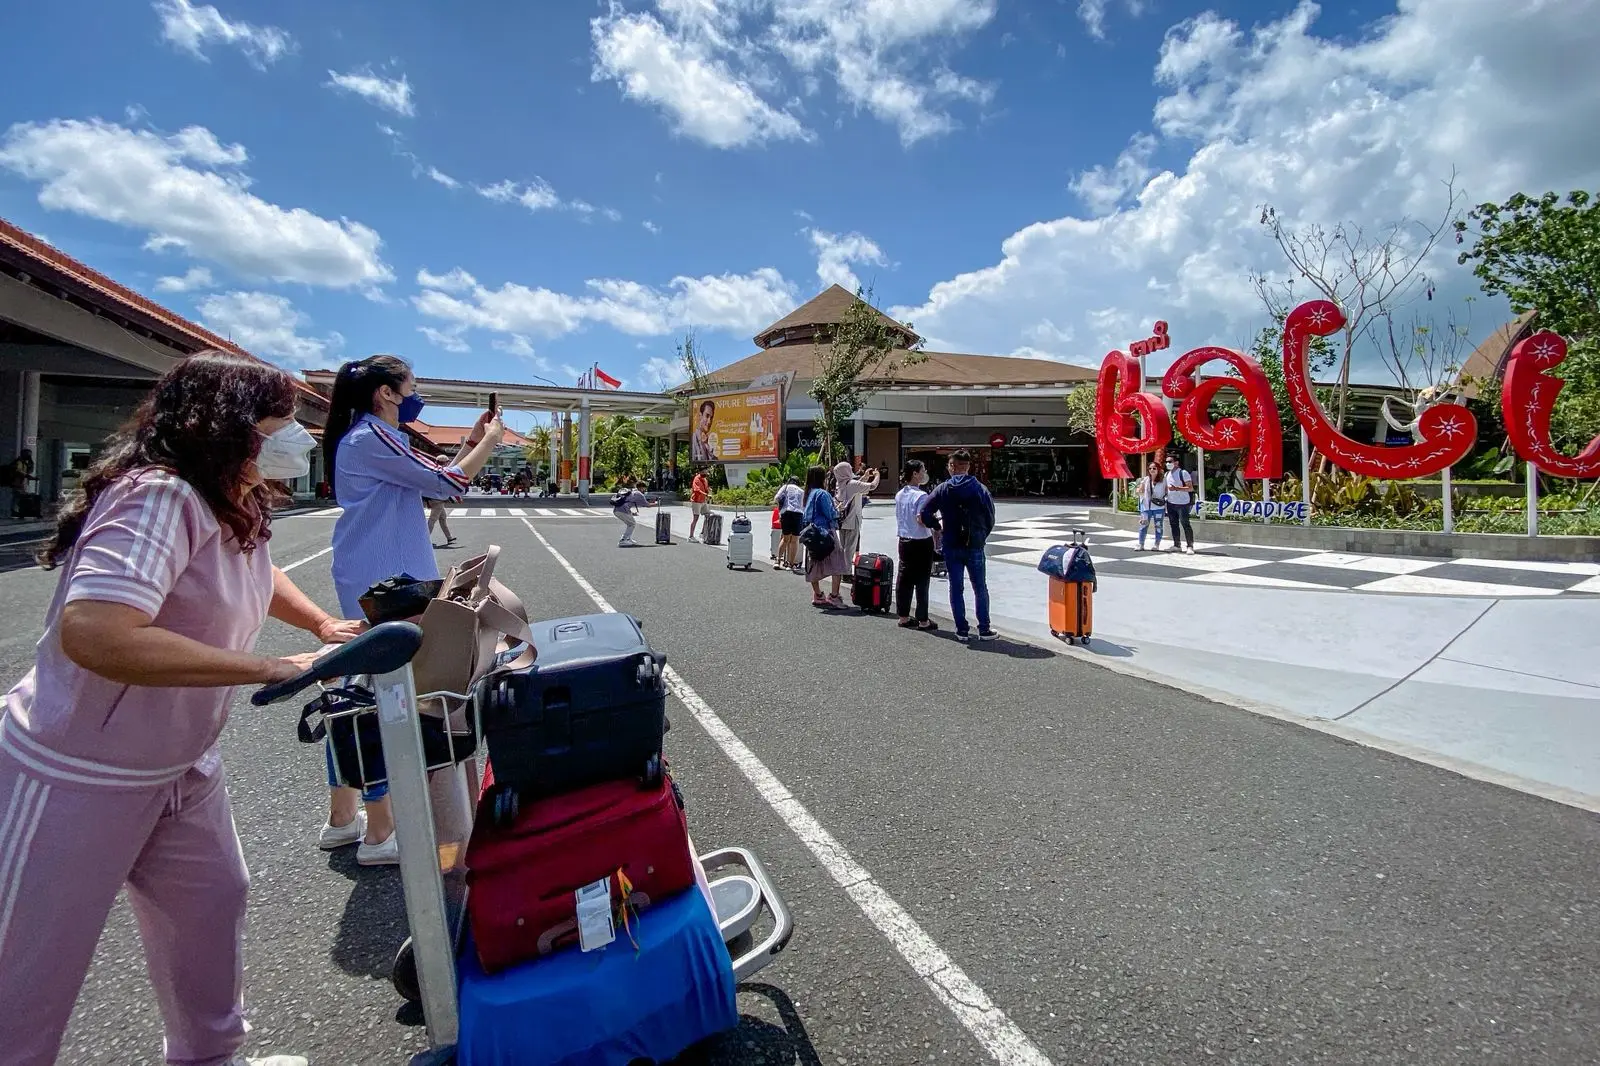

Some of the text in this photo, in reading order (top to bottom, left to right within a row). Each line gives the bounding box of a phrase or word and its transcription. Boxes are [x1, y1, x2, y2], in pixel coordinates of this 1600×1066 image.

[1011, 435, 1056, 445] Pizza Hut
[1219, 493, 1308, 520] PARADISE
